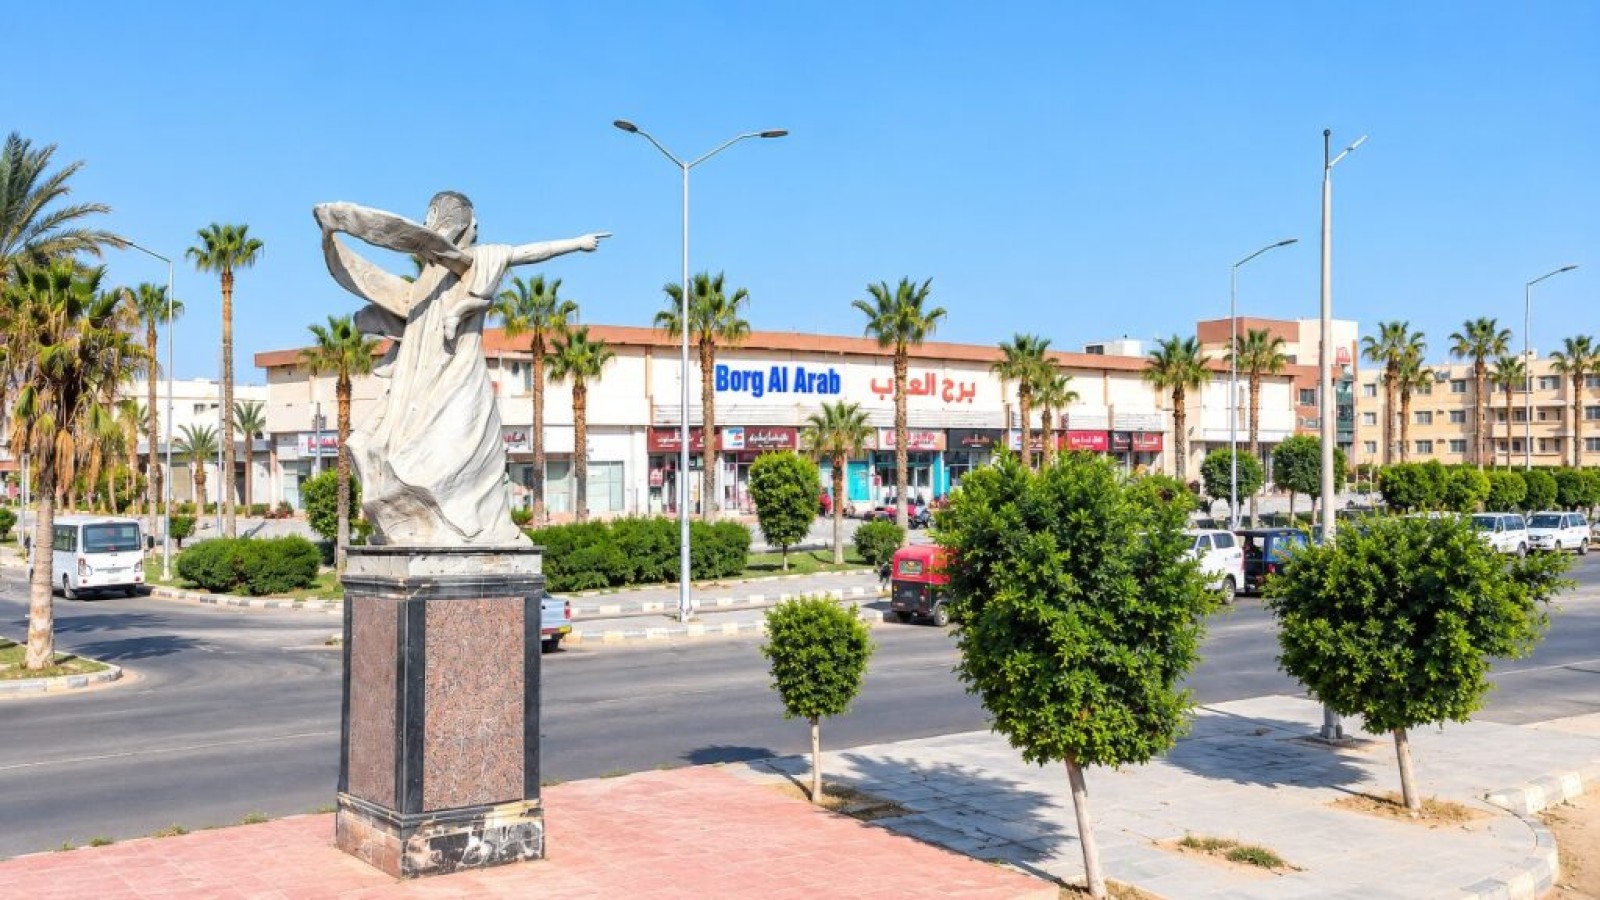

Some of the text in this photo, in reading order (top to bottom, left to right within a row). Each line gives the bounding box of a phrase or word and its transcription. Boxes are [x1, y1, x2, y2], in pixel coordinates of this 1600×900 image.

[715, 364, 841, 398] Borg Al Arab
[871, 373, 976, 403] برج العب
